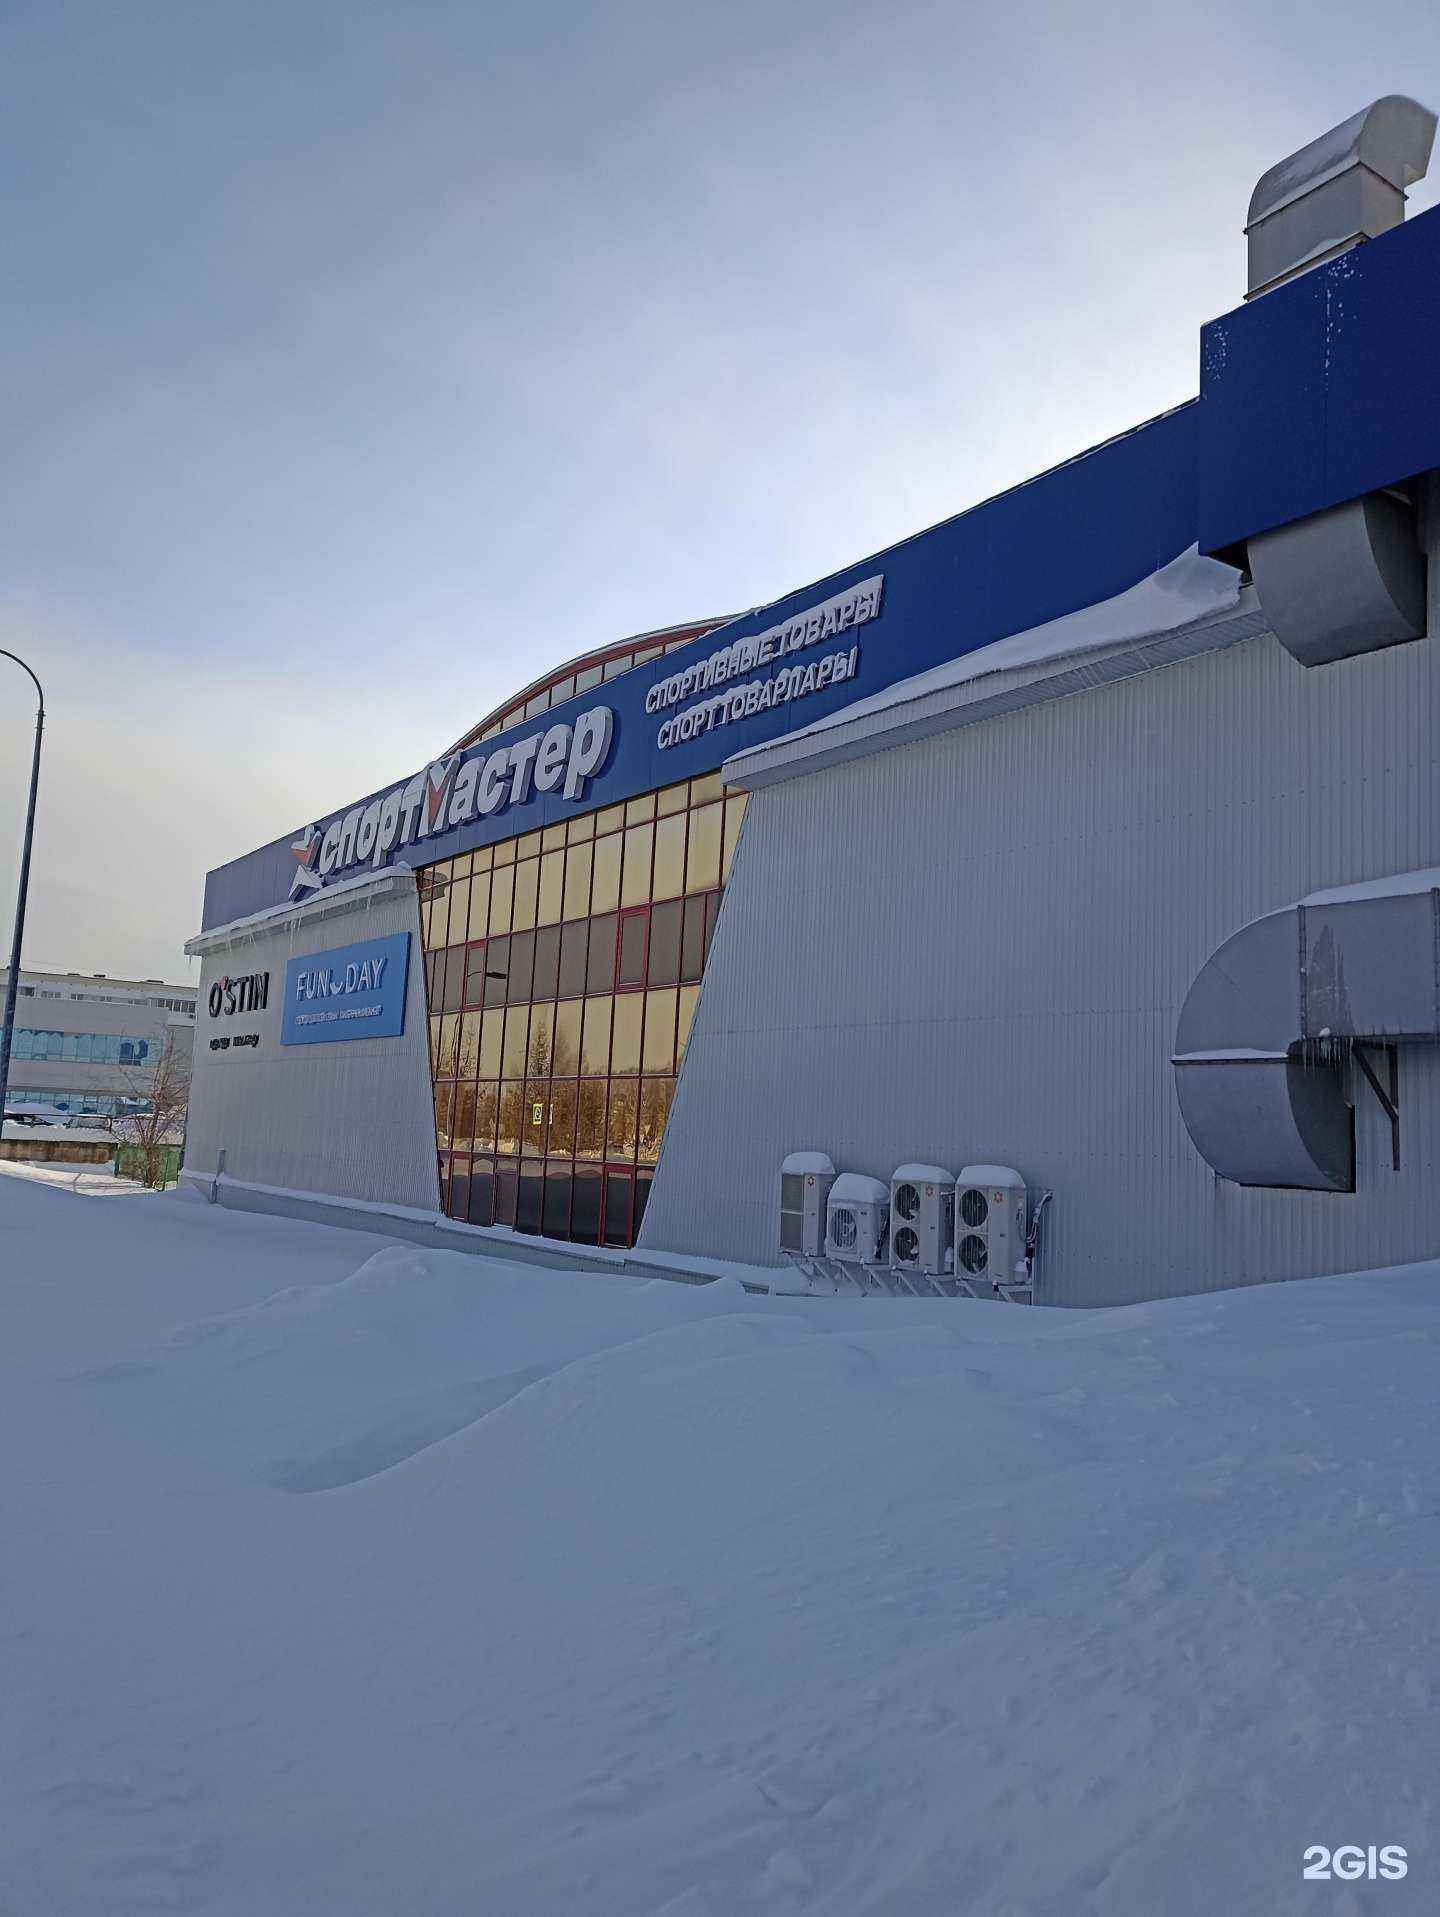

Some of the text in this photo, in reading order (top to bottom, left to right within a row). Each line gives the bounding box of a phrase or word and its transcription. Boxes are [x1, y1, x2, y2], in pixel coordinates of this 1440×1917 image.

[645, 579, 884, 714] СПОРТИВНЫЕ ТОВАРЫ
[208, 971, 270, 1018] O'STIN
[296, 956, 387, 1000] FUN DAY
